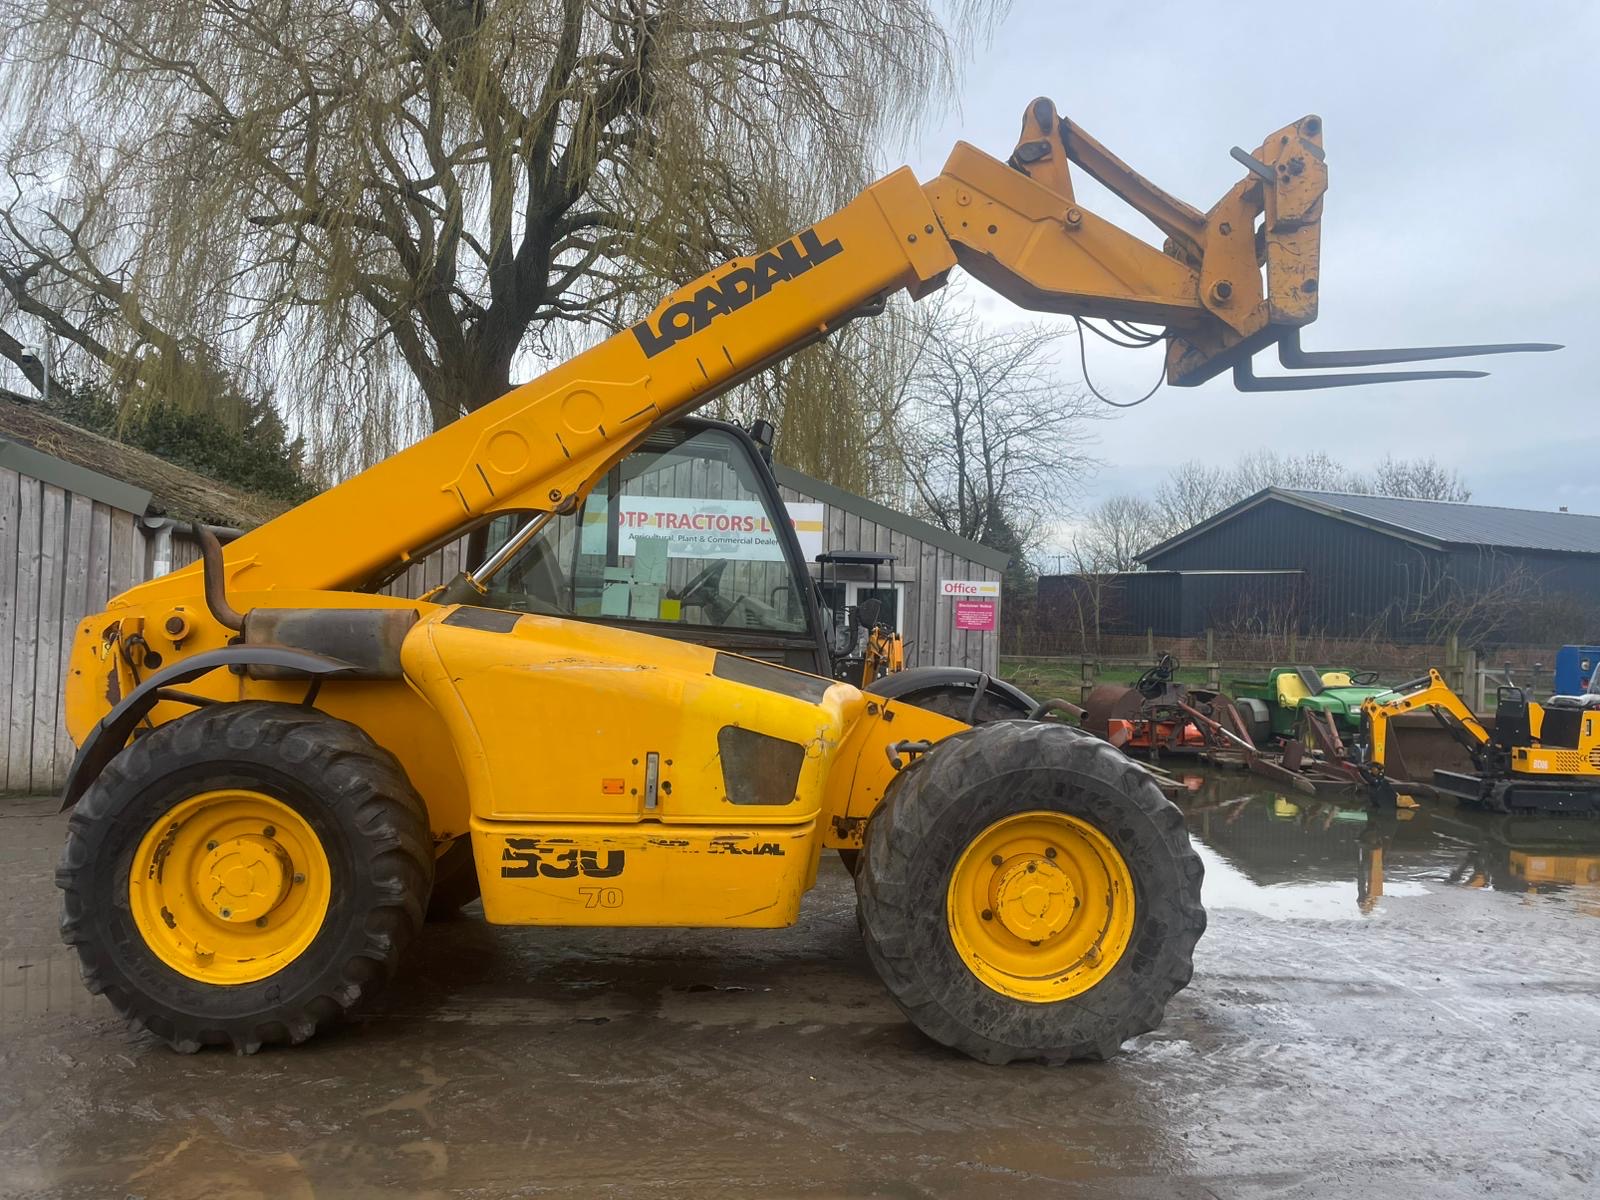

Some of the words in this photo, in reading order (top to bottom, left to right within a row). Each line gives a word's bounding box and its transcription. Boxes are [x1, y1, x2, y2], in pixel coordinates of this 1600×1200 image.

[631, 228, 844, 359] LOADALL
[654, 512, 754, 532] TRACTORS
[678, 534, 698, 543] Plant
[701, 535, 706, 543] &
[708, 536, 754, 546] Commercial
[944, 583, 977, 594] Office
[578, 887, 624, 909] 70
